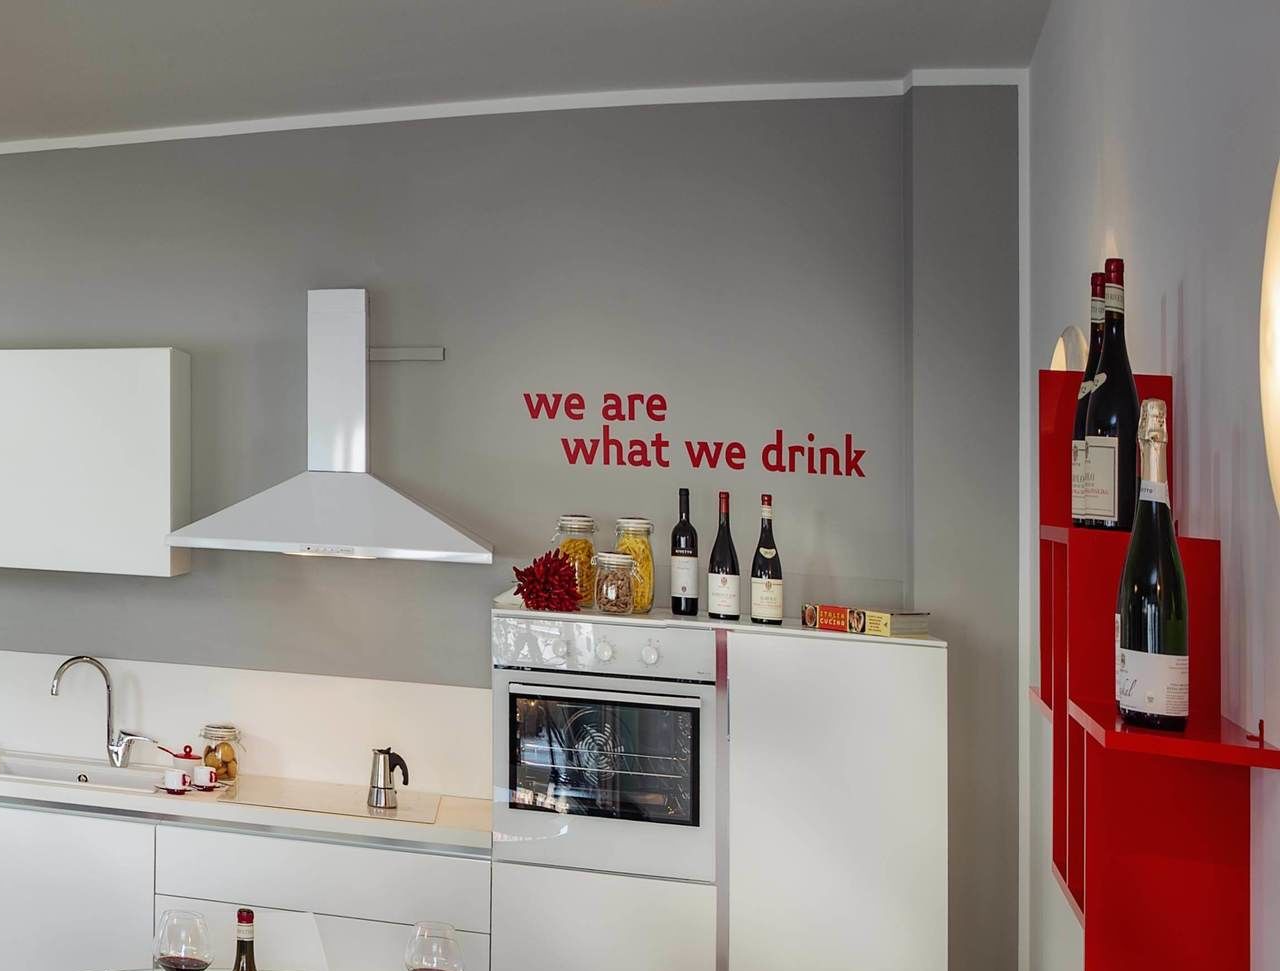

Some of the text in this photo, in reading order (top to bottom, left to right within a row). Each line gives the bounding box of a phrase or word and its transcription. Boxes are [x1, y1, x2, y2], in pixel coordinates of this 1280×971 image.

[524, 392, 667, 421] we are
[561, 425, 866, 477] what we drink
